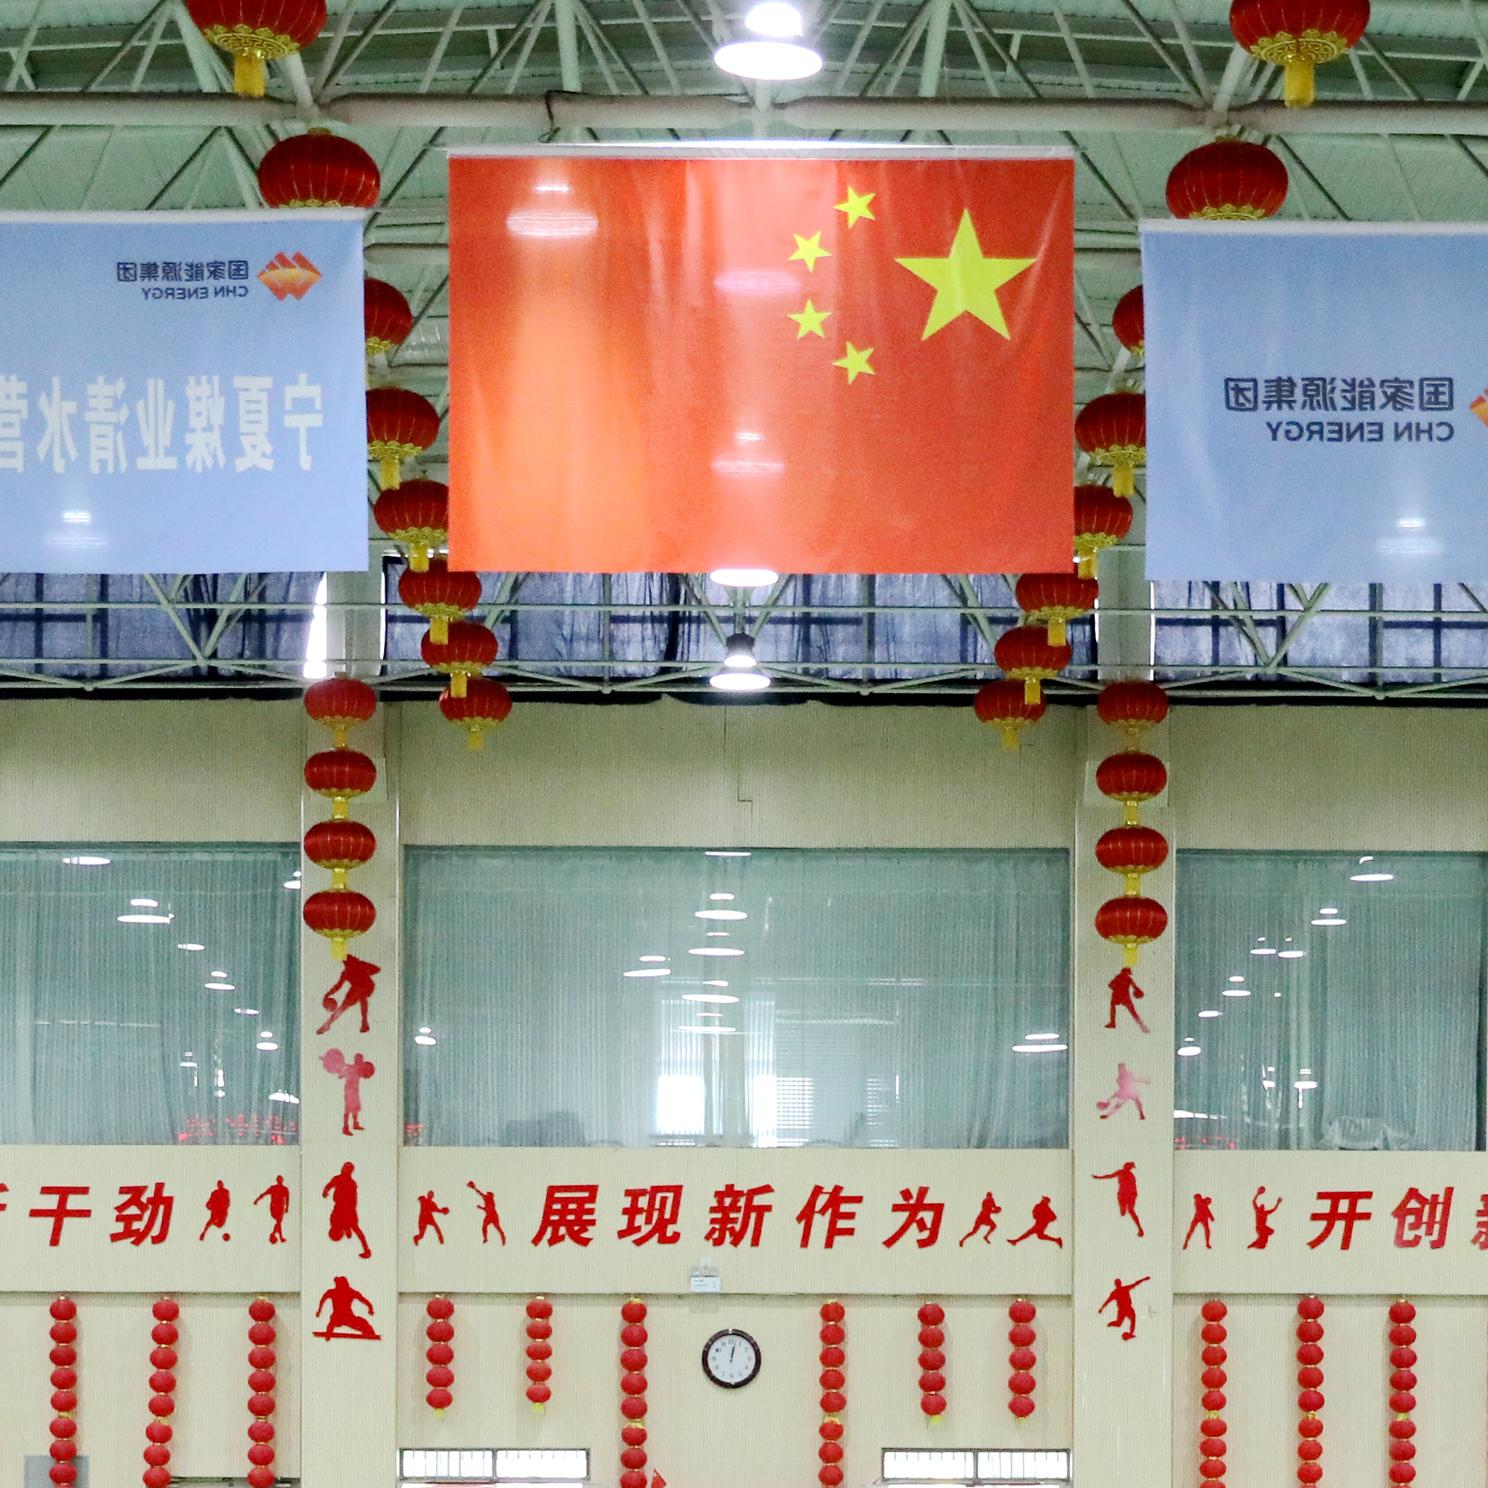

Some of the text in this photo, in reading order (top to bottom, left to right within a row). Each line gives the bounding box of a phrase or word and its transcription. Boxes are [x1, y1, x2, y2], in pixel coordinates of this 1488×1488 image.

[531, 1183, 946, 1249] 展现新作为
